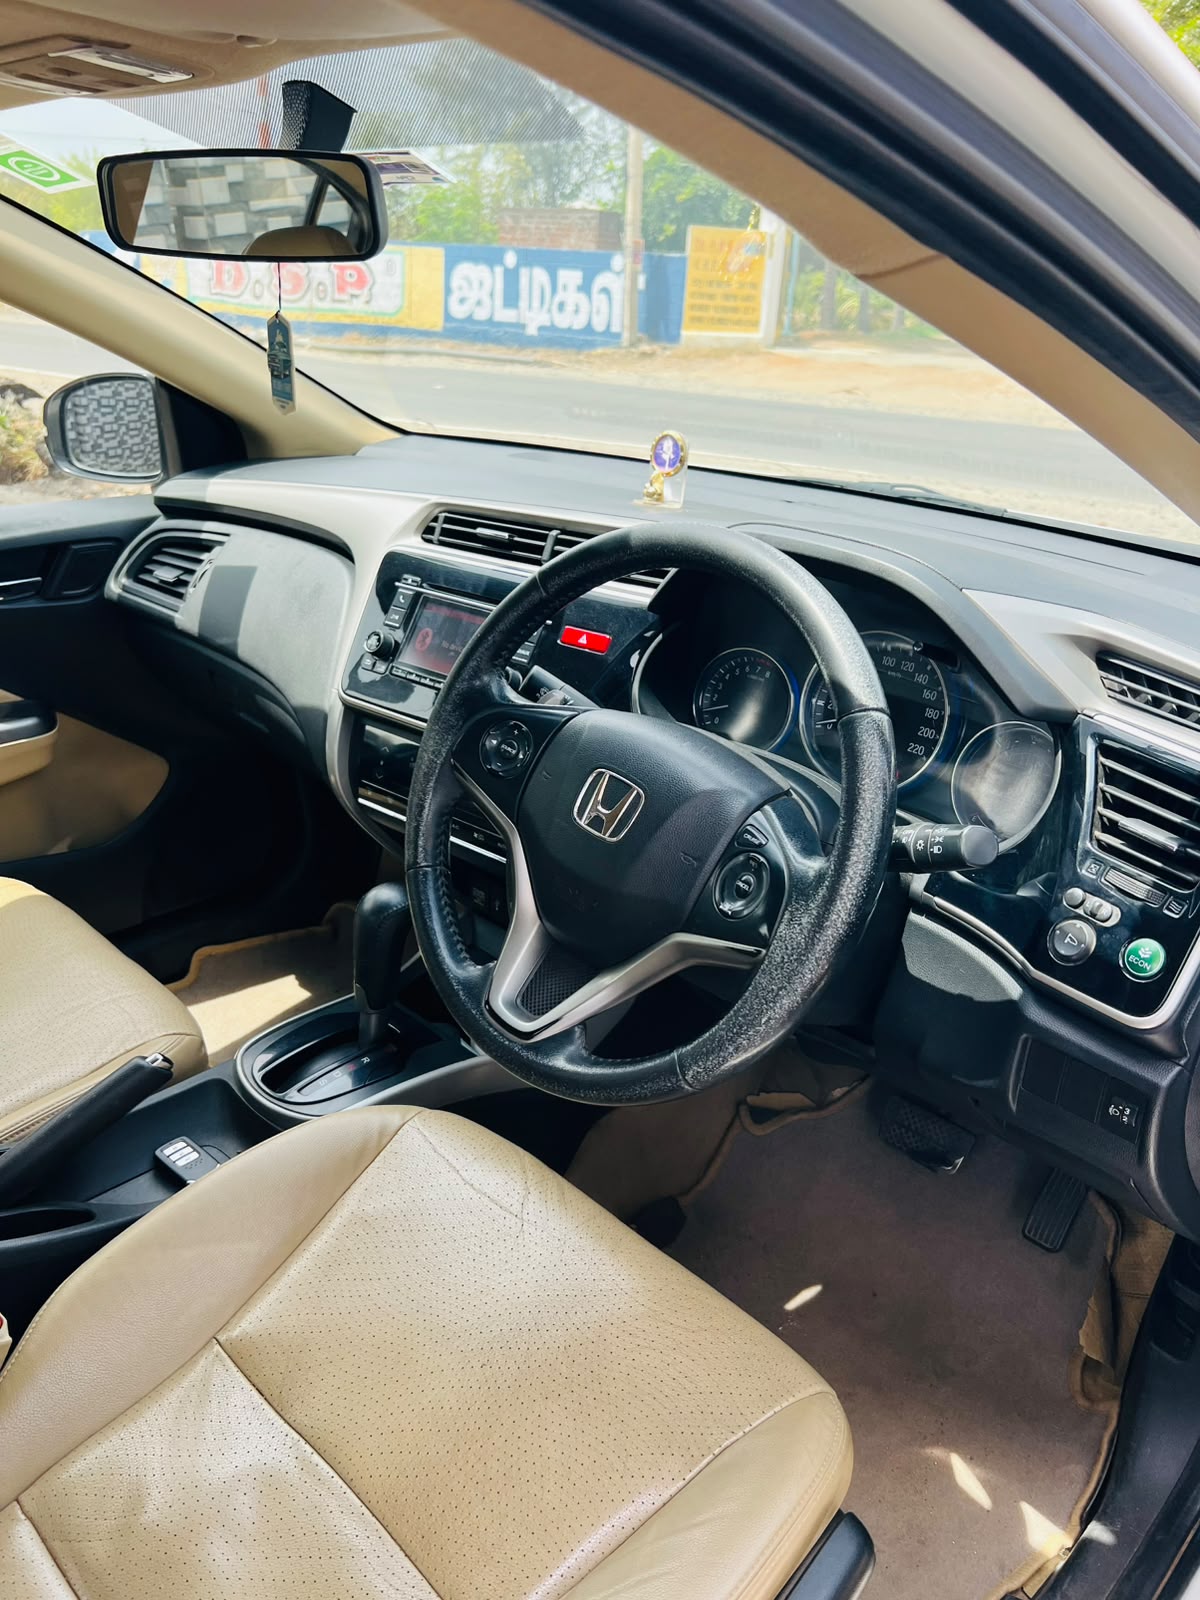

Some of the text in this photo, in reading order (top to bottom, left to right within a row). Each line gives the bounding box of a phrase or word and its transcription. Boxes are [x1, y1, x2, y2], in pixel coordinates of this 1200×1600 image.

[881, 655, 896, 667] 100
[900, 660, 915, 672] 120
[764, 670, 771, 679] 8
[914, 672, 929, 684] 140
[922, 688, 937, 700] 160
[925, 707, 940, 719] 180
[917, 726, 936, 739] 200
[907, 742, 925, 756] 220
[1128, 954, 1152, 971] ECON
[361, 1056, 370, 1064] R
[1123, 1107, 1131, 1115] 3
